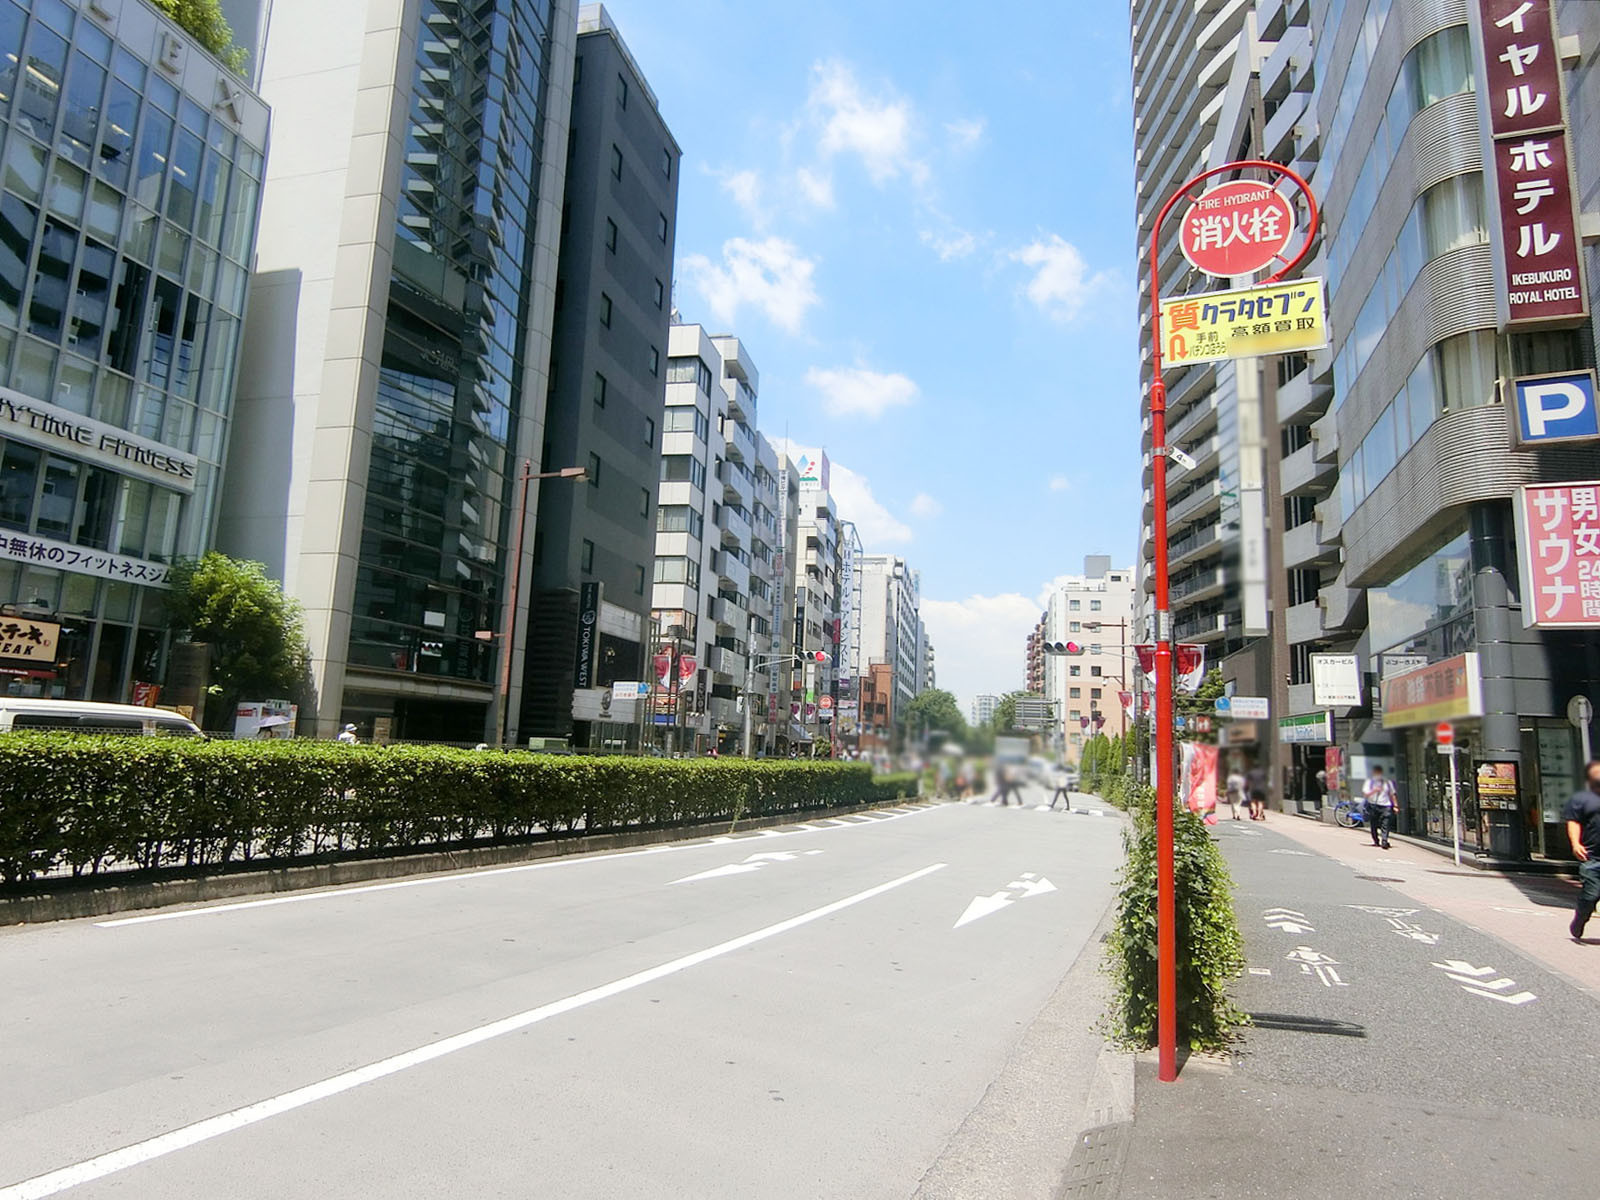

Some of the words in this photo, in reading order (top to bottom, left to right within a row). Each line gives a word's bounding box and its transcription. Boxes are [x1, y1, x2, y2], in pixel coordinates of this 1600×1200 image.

[1199, 199, 1221, 211] FIRE
[1223, 189, 1271, 206] HYDRANT
[1190, 205, 1284, 253] 消火栓
[1512, 268, 1572, 286] IKEBUKURO
[1509, 290, 1543, 305] ROYAL
[1543, 286, 1579, 302] HOTEL
[1524, 382, 1587, 436] P
[99, 434, 196, 480] FITNESS
[1533, 489, 1576, 619] サウナ
[0, 642, 35, 656] EAK
[579, 662, 588, 688] WEST
